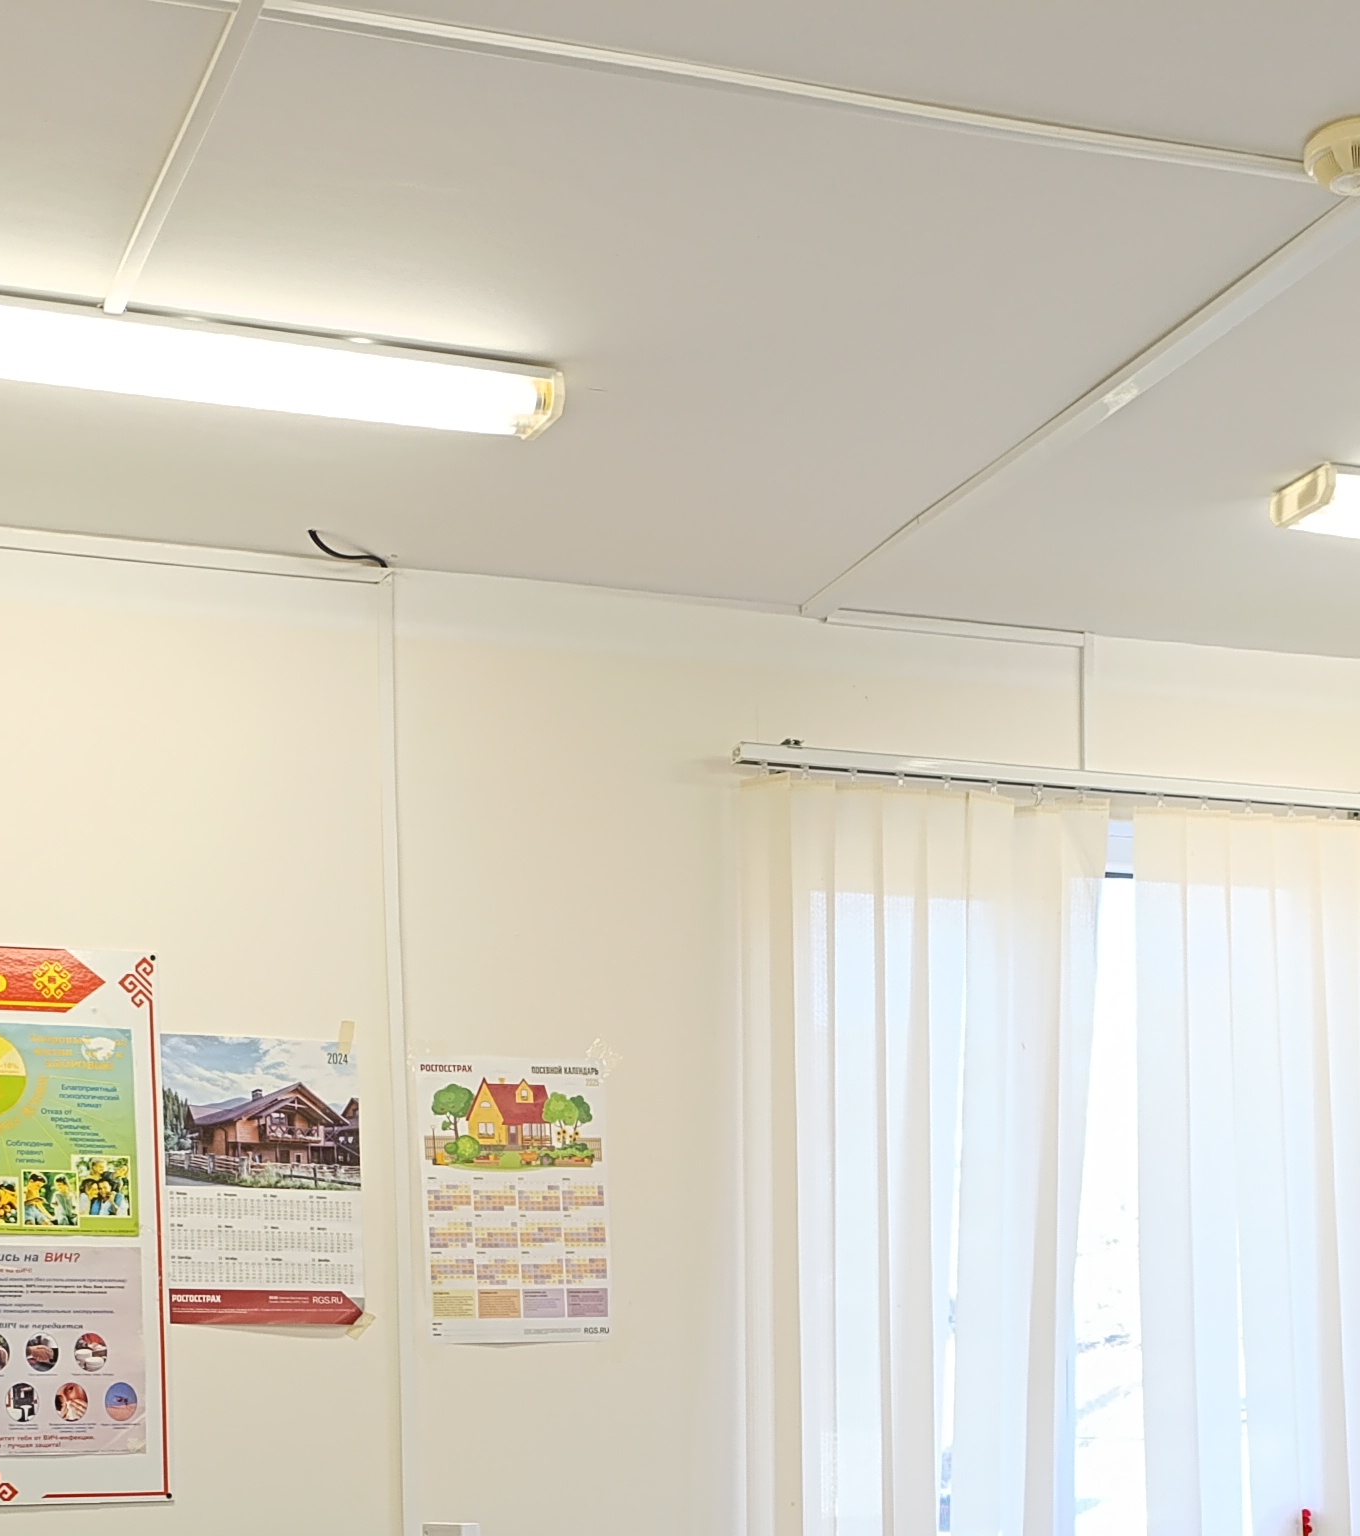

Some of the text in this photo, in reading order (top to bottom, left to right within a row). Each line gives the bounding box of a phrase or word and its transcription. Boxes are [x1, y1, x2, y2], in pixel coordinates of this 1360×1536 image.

[327, 1052, 349, 1065] 2024
[419, 1064, 473, 1073] РОСГОССТРАХ
[530, 1065, 599, 1076] ПОСЕВНОЙ КАЛЕНДАРЬ
[61, 1083, 118, 1093] Благоприятный
[58, 1093, 120, 1101] психологический
[40, 1107, 63, 1115] Отказ
[5, 1139, 54, 1148] Соблюдение
[23, 1253, 40, 1262] на
[43, 1251, 82, 1263] ВИЧ?
[171, 1293, 222, 1304] РОСГОССТРАХ
[311, 1295, 344, 1305] RGS.RU
[31, 1322, 84, 1330] передается
[583, 1326, 610, 1336] RGS.RU
